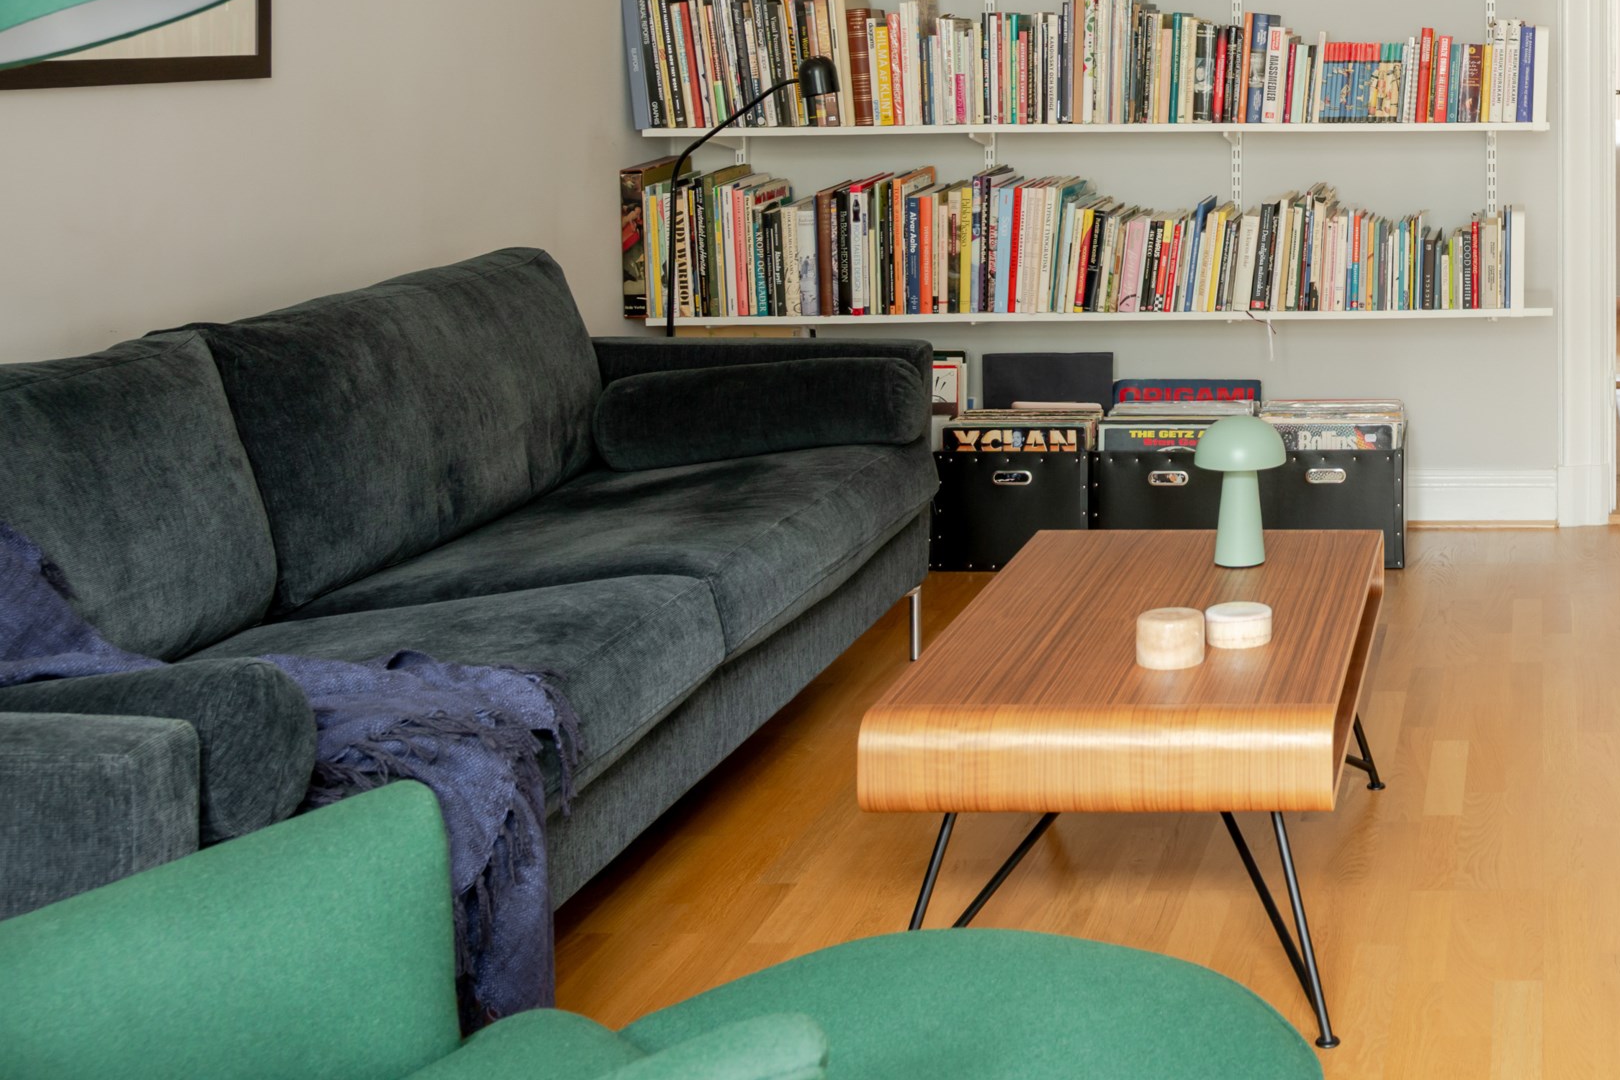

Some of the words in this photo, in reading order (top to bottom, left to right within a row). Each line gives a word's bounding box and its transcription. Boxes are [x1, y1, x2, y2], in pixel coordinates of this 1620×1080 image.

[772, 34, 781, 62] Persuasion
[1266, 55, 1280, 102] MASSMEDIER
[1510, 72, 1518, 104] MURAKAMI
[651, 101, 660, 125] GRAPHIS
[880, 83, 893, 117] KLINT
[961, 197, 972, 219] Pablo
[674, 209, 686, 245] ANDY
[960, 220, 970, 247] Picasso
[755, 231, 765, 258] KROPP
[1041, 228, 1051, 273] TYPOGRAFISKT
[1153, 228, 1163, 258] BAUHAUS
[1129, 430, 1156, 439] THE
[1158, 430, 1195, 439] GETZ
[1298, 431, 1358, 450] Rollins
